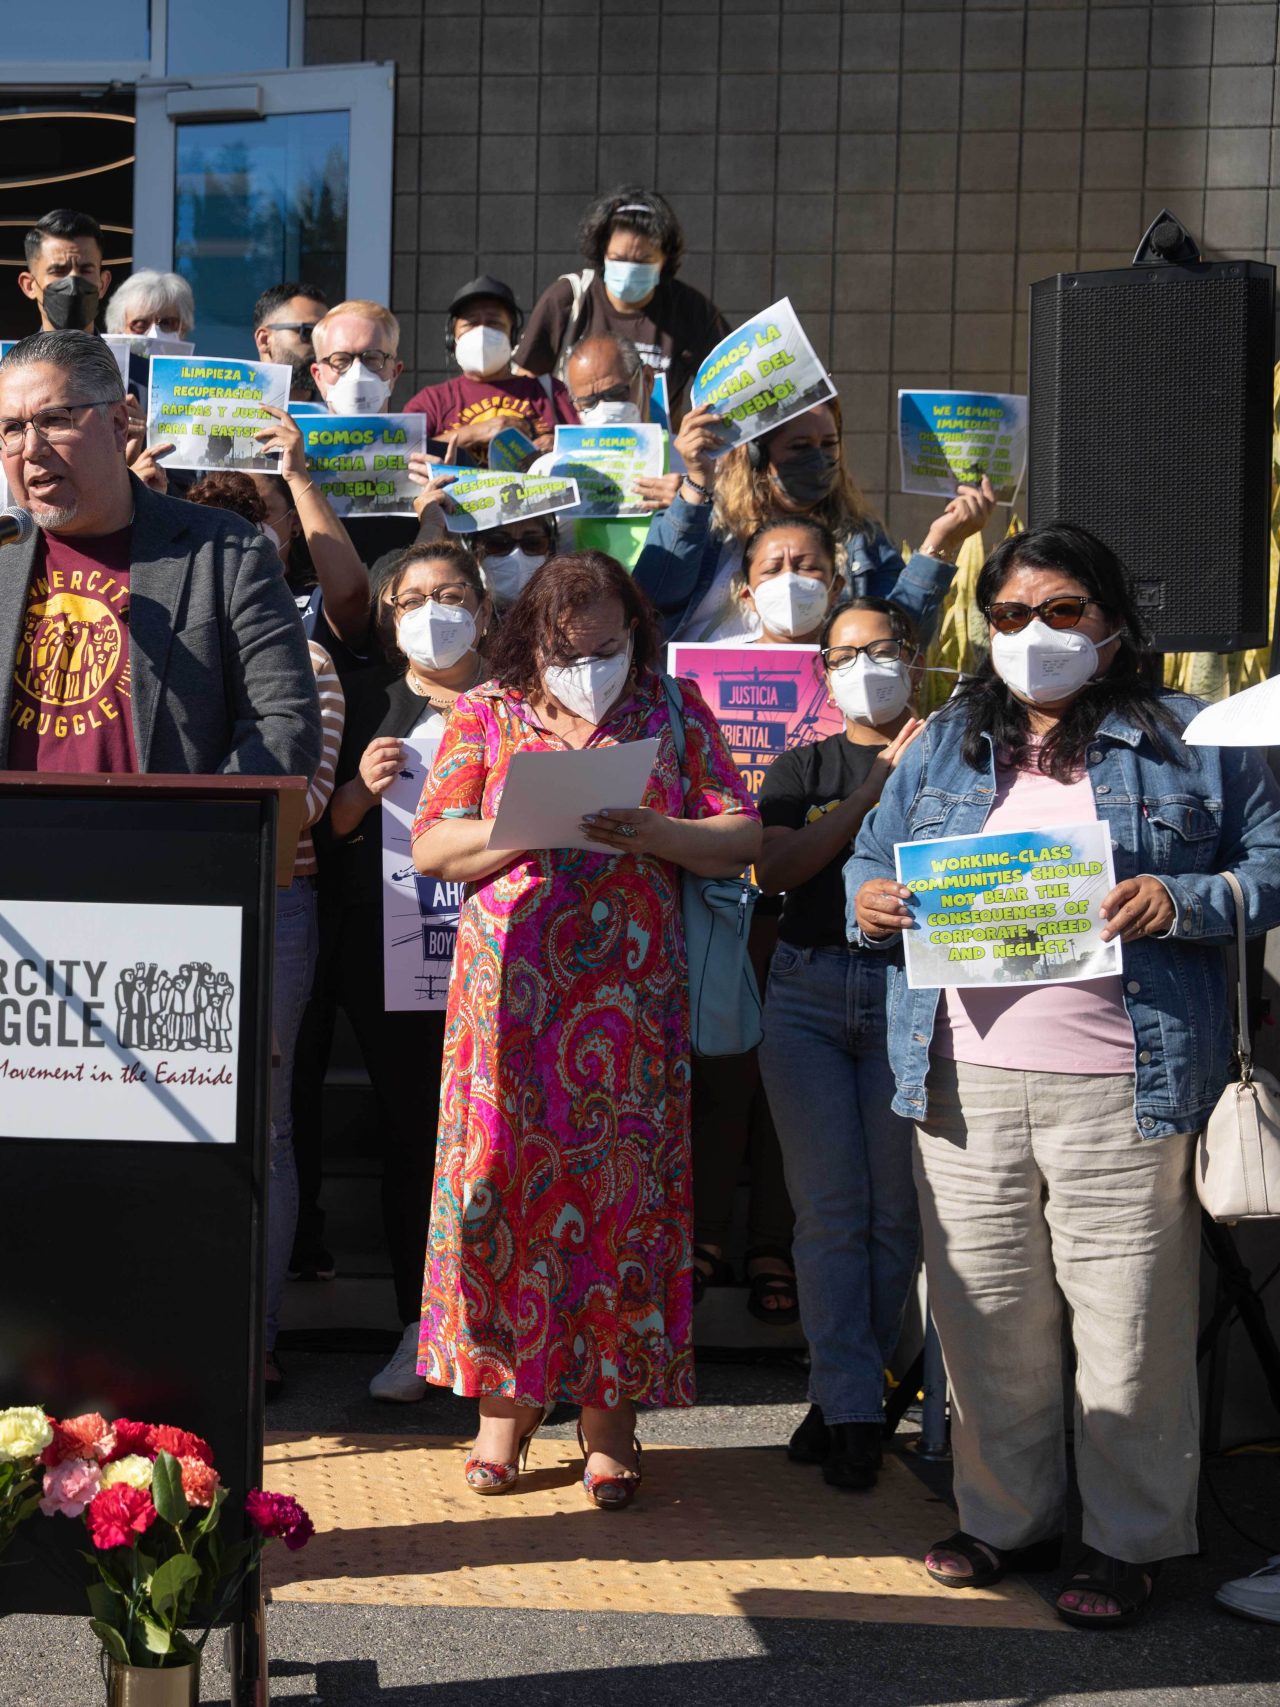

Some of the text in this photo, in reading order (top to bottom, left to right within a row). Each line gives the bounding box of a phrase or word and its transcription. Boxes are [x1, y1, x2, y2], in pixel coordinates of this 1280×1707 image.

[699, 340, 751, 389] SOMOS
[754, 324, 782, 348] LA
[249, 371, 257, 382] Y
[707, 350, 796, 405] UCHA DEL
[218, 407, 227, 418] Y
[722, 378, 797, 428] PUEBLO!
[933, 406, 1004, 418] WE DEMAND
[158, 423, 206, 436] PARA EL
[308, 430, 407, 445] SOMOS LA
[581, 437, 638, 447] WE DEMAND
[306, 455, 408, 472] LUCHA DEL
[321, 480, 395, 497] PUEBLO!
[501, 493, 510, 504] Y
[729, 686, 779, 705] JUSTICIA
[10, 697, 118, 737] TRUGGLE
[930, 845, 1073, 873] WORKING-CLASS
[906, 861, 1103, 893] COMMUNITIES SHOULD
[940, 883, 1070, 908] NOT BEAR THE
[927, 900, 1090, 927] CONSEQUENCES OF
[930, 918, 1091, 945] CORPORATE GREED
[948, 947, 986, 961] AND
[90, 1064, 113, 1083] in
[120, 1062, 147, 1084] the
[154, 1061, 233, 1086] Eastside
